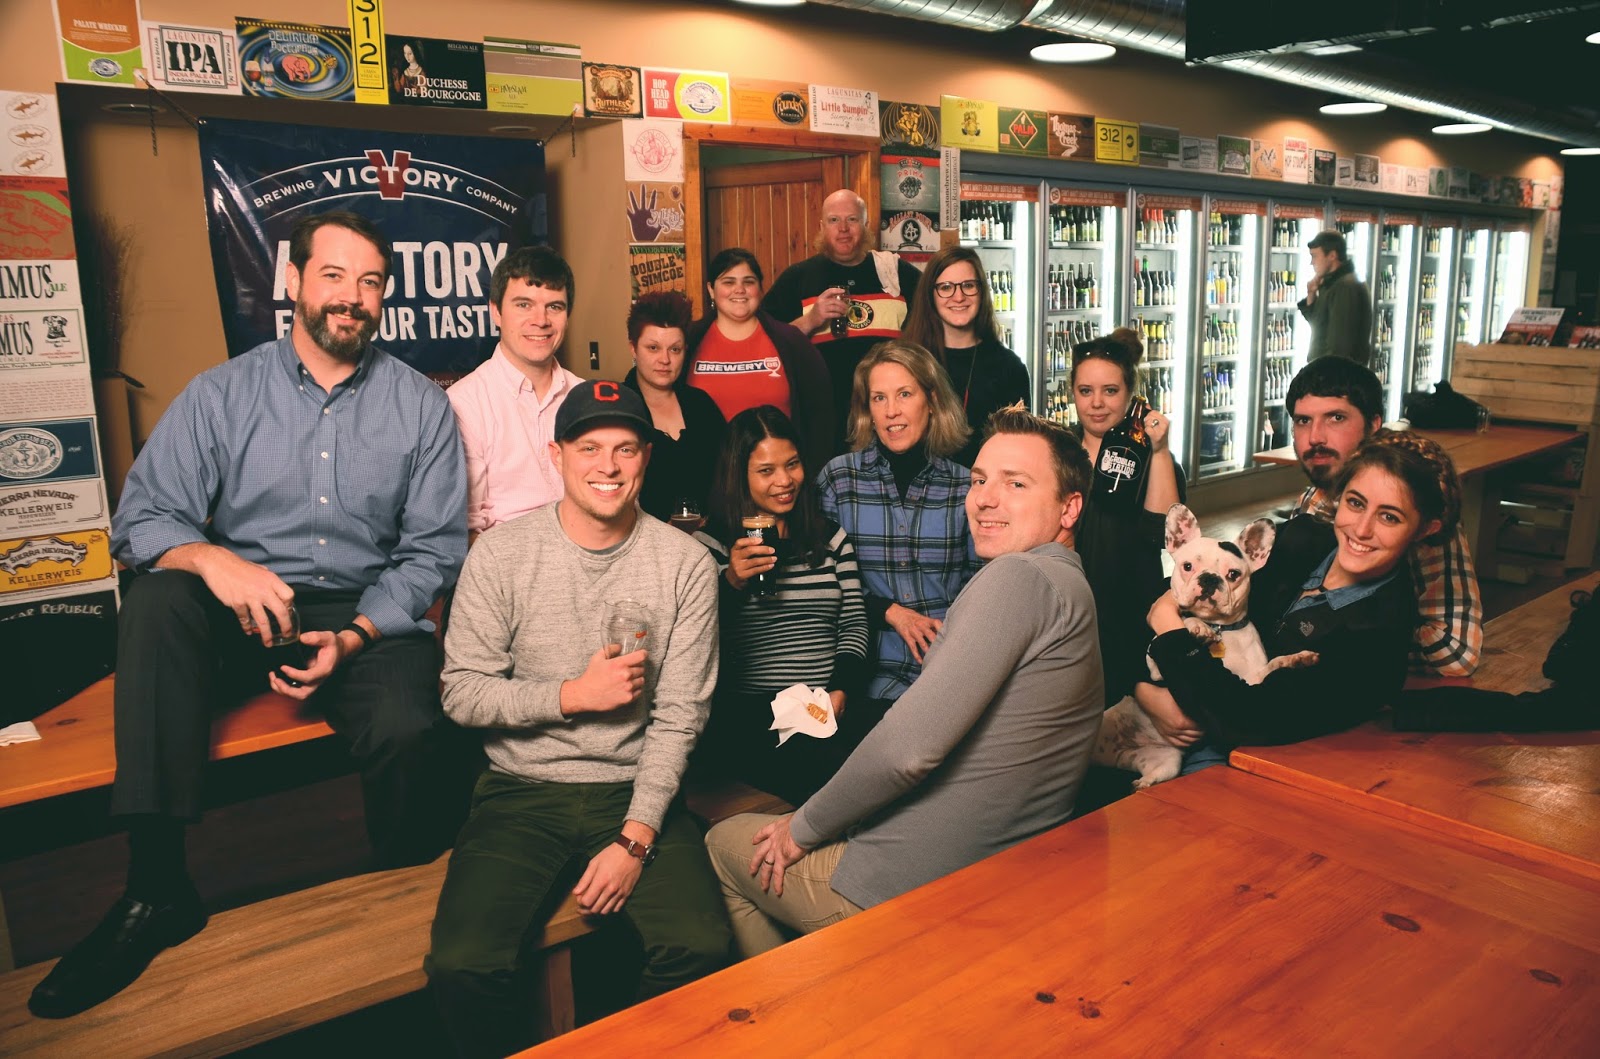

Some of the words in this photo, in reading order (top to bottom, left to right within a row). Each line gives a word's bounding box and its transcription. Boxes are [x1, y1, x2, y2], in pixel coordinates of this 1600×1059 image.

[166, 31, 217, 43] LAGUNITAS
[268, 30, 319, 44] DELIRIUM
[165, 41, 222, 74] IPA
[416, 74, 468, 89] DUCHESSE
[652, 79, 667, 89] HOP
[404, 87, 418, 97] DE
[420, 86, 482, 102] BOURGOGNE
[650, 89, 670, 99] HEAD
[827, 88, 862, 98] LAGUNITAS
[595, 98, 631, 109] RUTHLESS
[653, 99, 668, 109] RED
[821, 101, 841, 112] Little
[1013, 123, 1034, 135] PALM
[1100, 127, 1120, 142] 312
[898, 169, 924, 178] PRIMA
[253, 180, 315, 208] BREWING
[322, 165, 459, 193] VICTORY
[466, 186, 518, 214] COMPANY
[630, 255, 676, 276] DOUBLE
[641, 267, 684, 287] SIMCOE
[49, 283, 67, 292] ALE
[697, 361, 764, 372] BREWERY
[593, 381, 620, 402] C
[16, 433, 40, 444] STEAM
[33, 489, 76, 501] NEVADA
[0, 502, 73, 516] KELLERWEIS
[9, 548, 41, 563] SIERRA
[41, 547, 76, 556] NEVADA
[8, 569, 82, 585] KELLERWEIS
[40, 603, 103, 615] REPUBLIC
